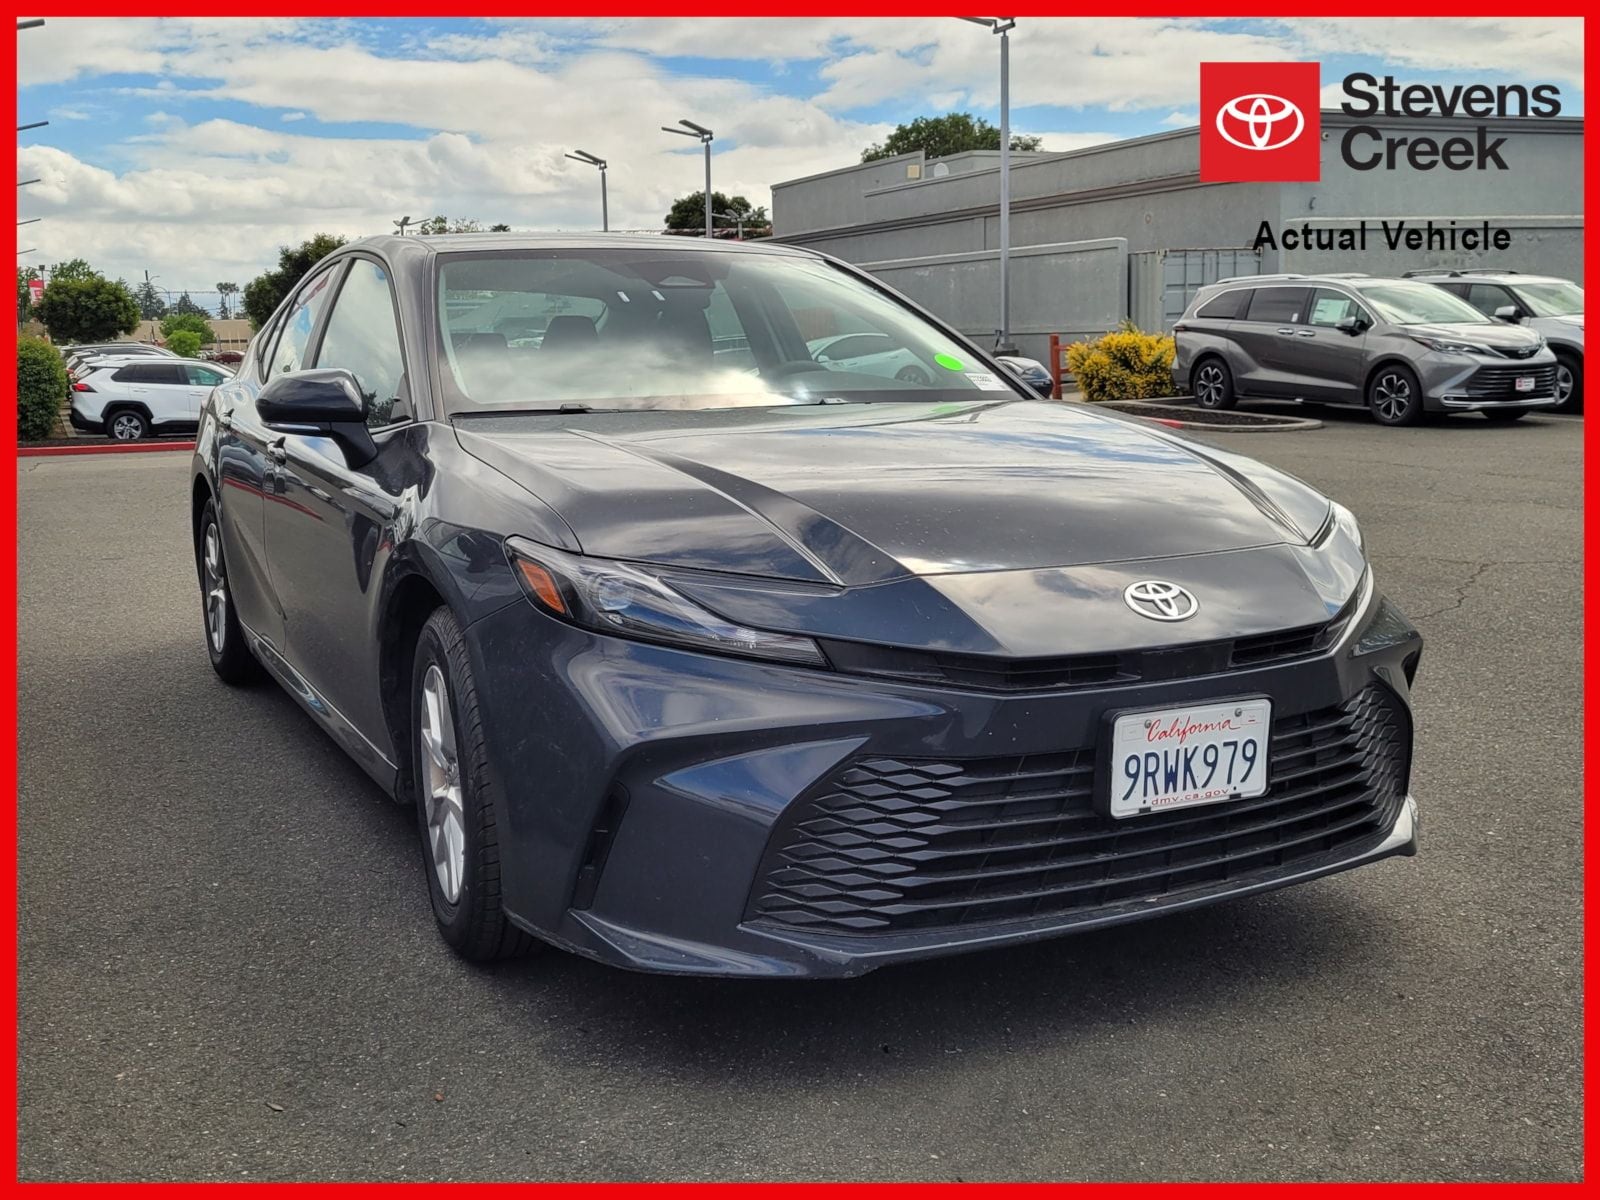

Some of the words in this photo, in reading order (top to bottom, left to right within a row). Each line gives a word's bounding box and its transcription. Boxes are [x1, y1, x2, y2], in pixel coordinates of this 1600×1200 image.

[1146, 715, 1241, 744] California
[1122, 738, 1258, 801] 9RWK979
[1151, 788, 1229, 806] dmv.ca.gov
